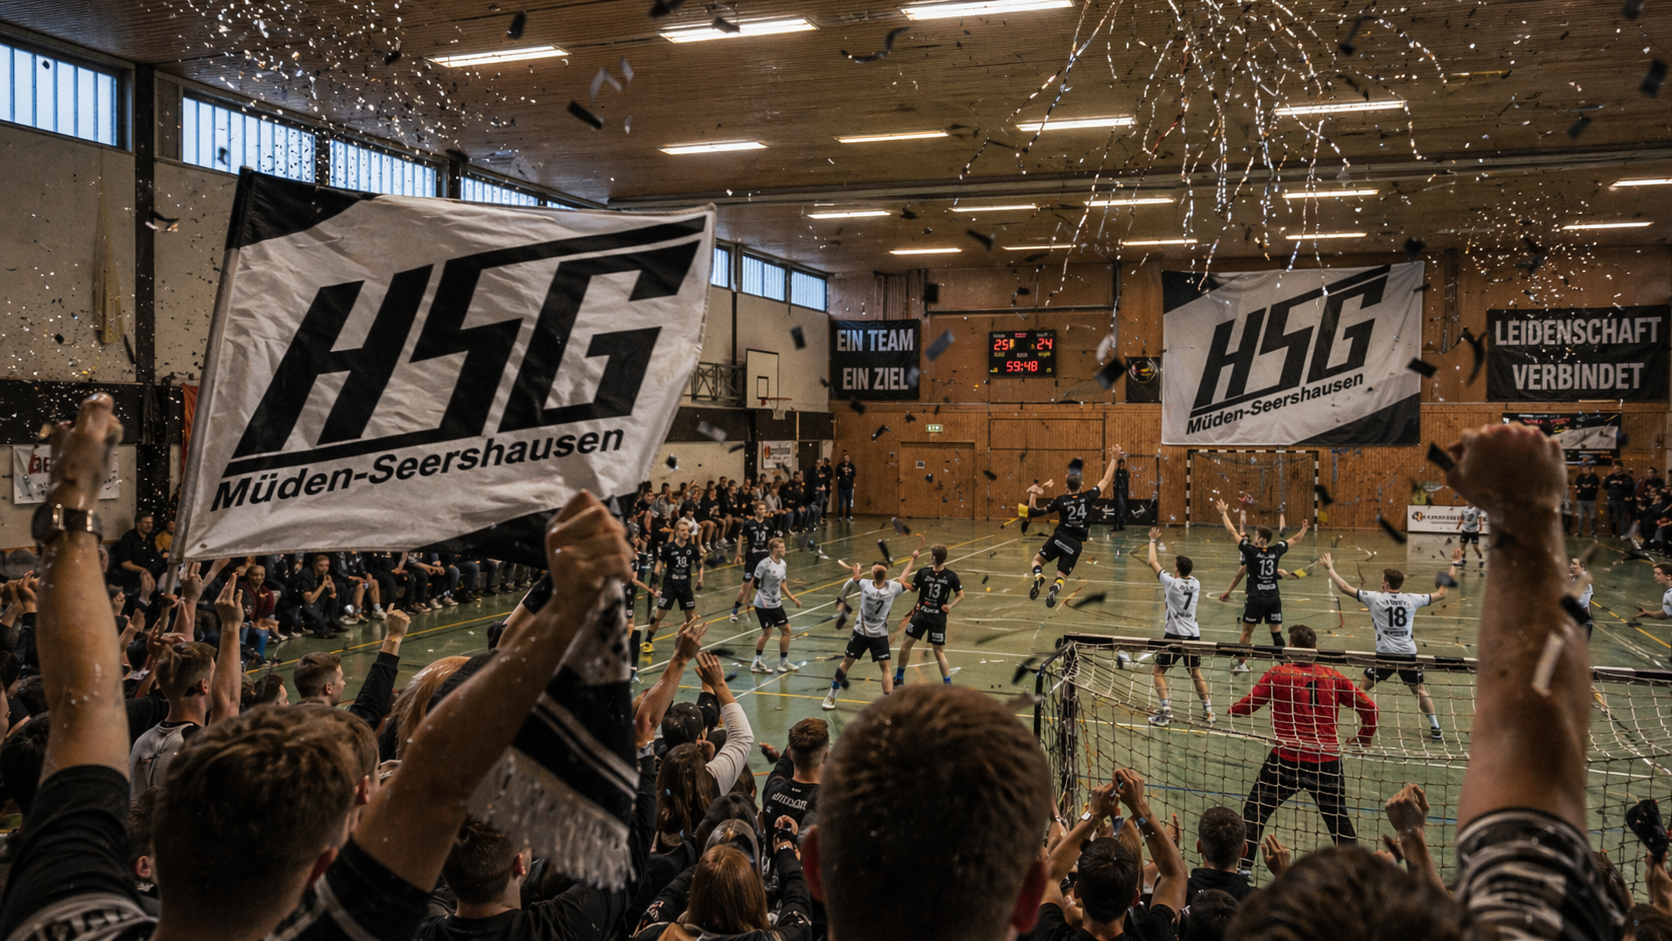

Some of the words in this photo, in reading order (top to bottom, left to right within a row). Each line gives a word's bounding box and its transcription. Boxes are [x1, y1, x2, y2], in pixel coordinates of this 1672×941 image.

[837, 329, 863, 351] EIN
[867, 329, 914, 351] TEAM
[1190, 265, 1391, 418] HSG
[1495, 316, 1662, 346] LEIDENSCHAFT
[222, 215, 706, 478] HSG
[993, 339, 1009, 351] 25
[1036, 337, 1053, 350] 24
[1006, 360, 1038, 373] 59:48
[1512, 362, 1645, 390] VERBINDET
[843, 367, 869, 390] EIN
[873, 367, 909, 390] ZIEL
[1186, 373, 1363, 435] Müden-Seershausen
[210, 428, 623, 511] Müden-Seershausen
[1066, 503, 1088, 520] 24
[1259, 559, 1274, 576] 13
[928, 582, 942, 599] 13
[1183, 591, 1193, 611] 7
[1384, 605, 1408, 628] 18
[1304, 680, 1320, 711] 1
